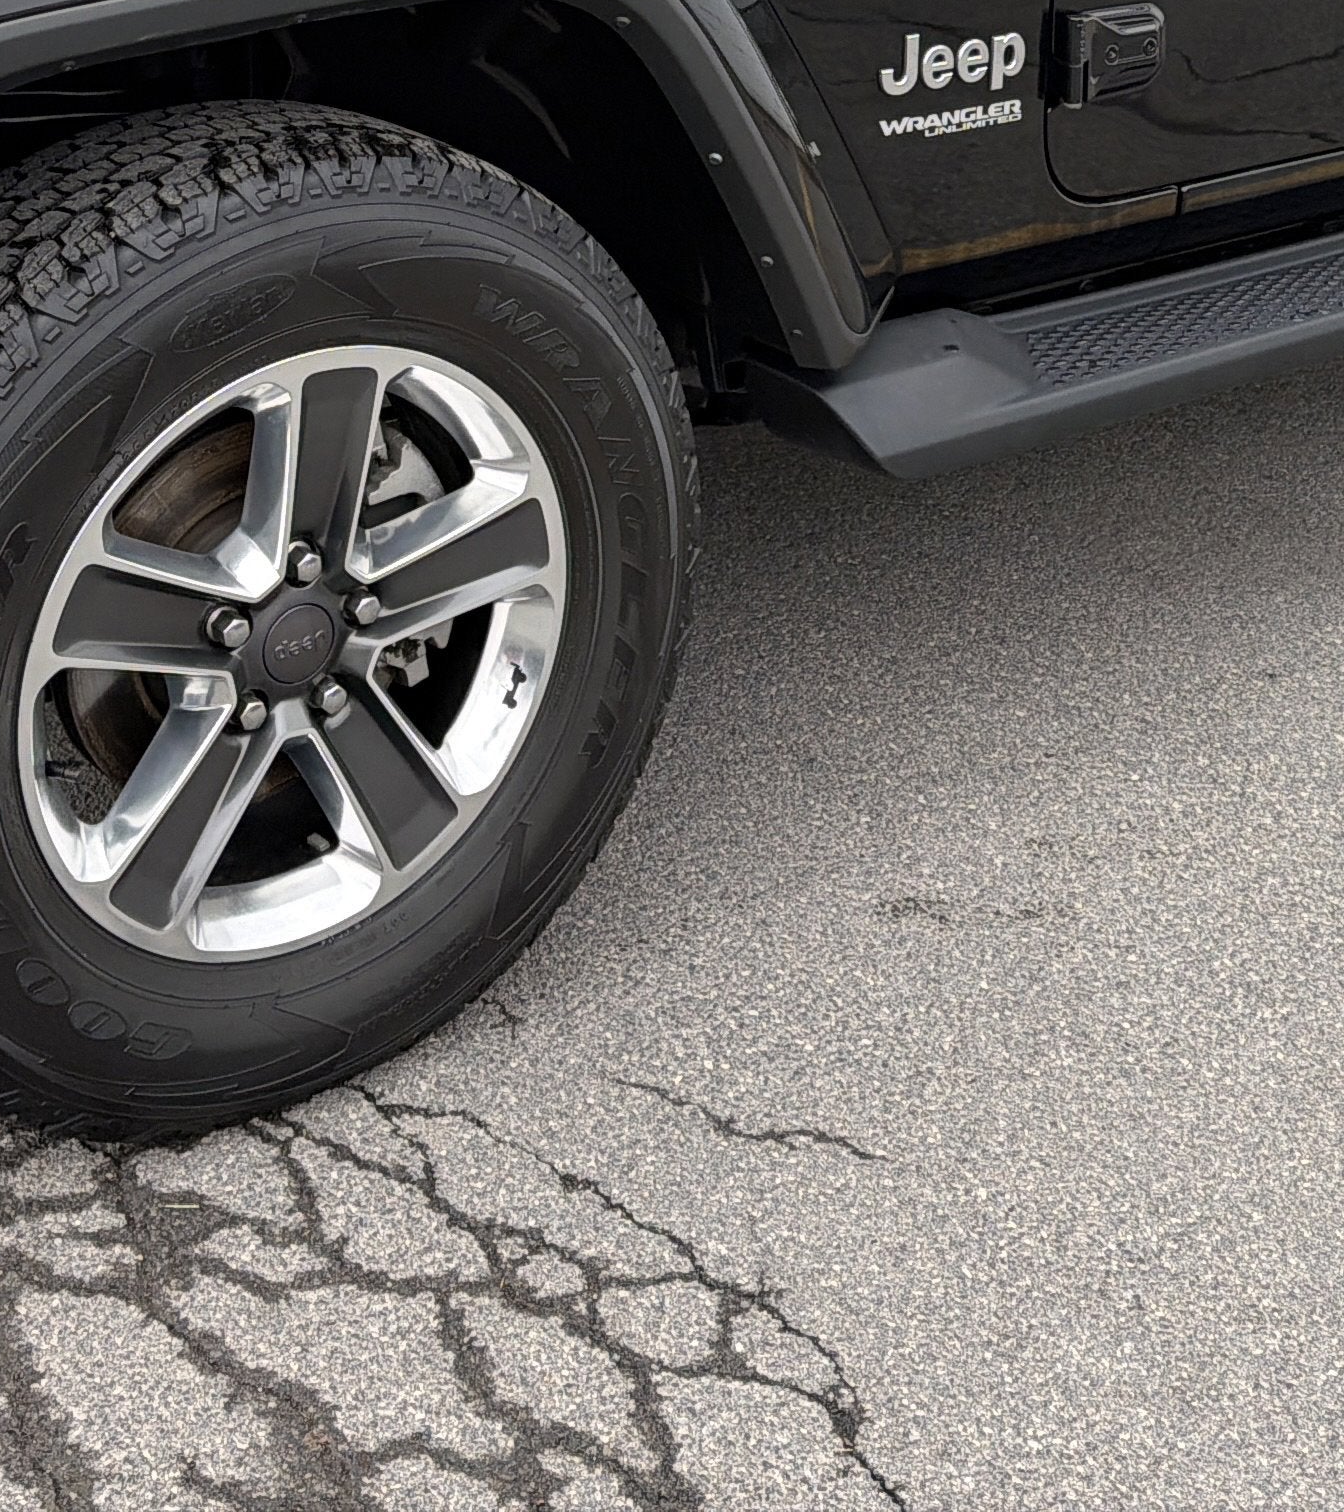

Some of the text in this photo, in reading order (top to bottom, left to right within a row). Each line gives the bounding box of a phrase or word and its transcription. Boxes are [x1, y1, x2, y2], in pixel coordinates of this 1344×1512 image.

[879, 32, 1027, 96] Jeep
[879, 99, 1023, 137] WRANGLER
[924, 113, 1023, 138] UNLIMITED
[476, 283, 650, 769] WRANGLER
